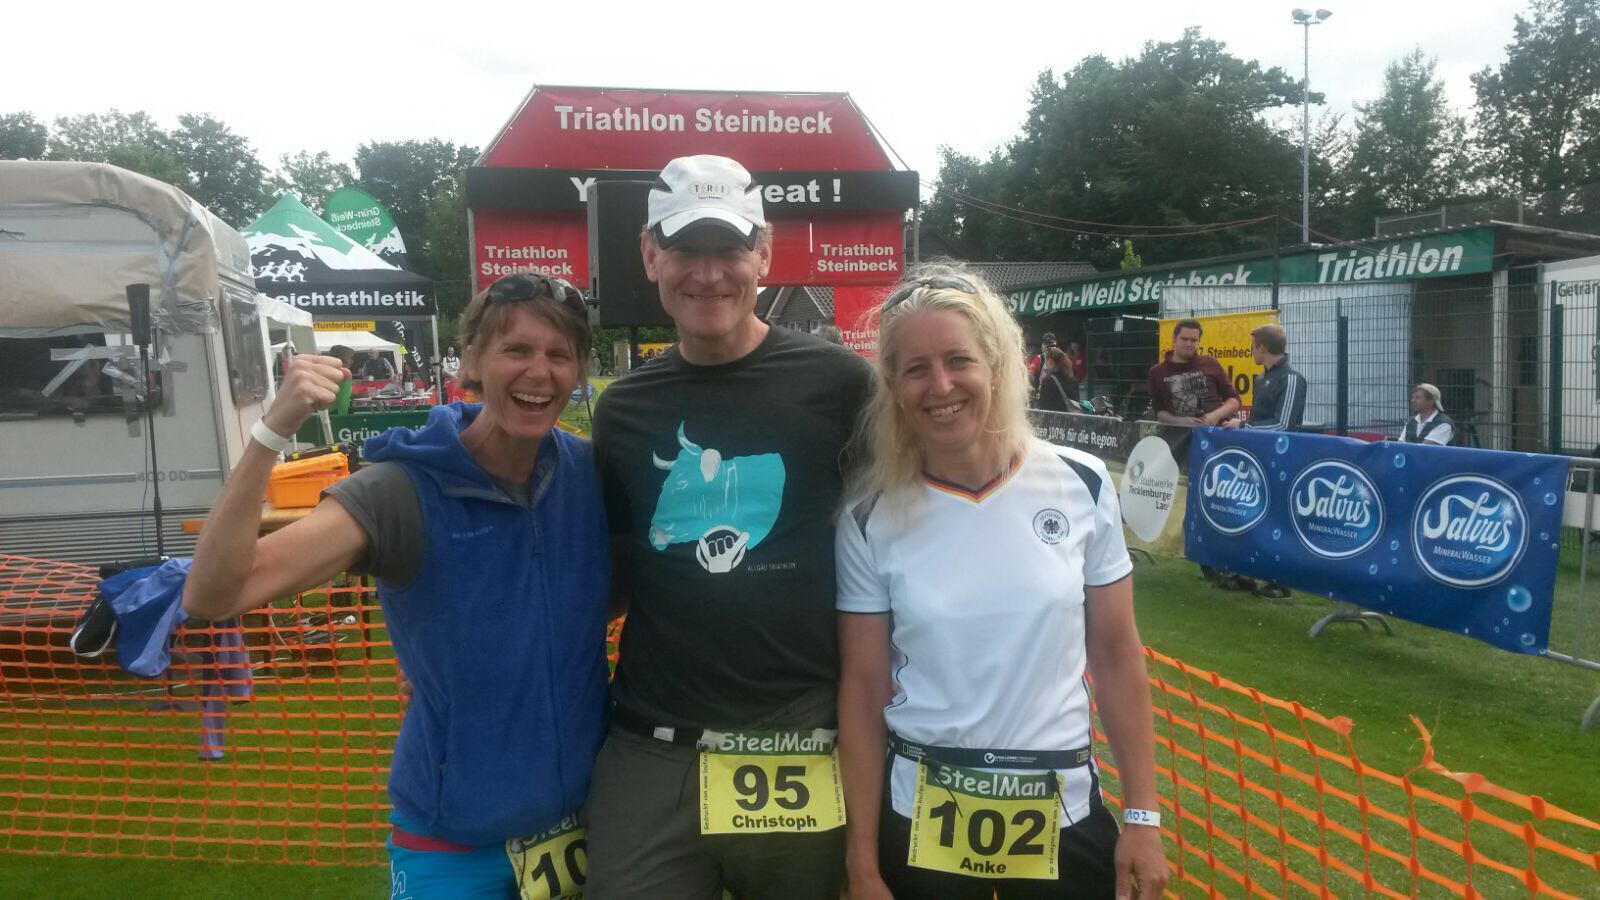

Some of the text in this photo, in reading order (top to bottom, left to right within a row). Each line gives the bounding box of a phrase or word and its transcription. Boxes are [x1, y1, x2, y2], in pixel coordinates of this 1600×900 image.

[554, 105, 833, 135] Triathlon Steinbeck
[758, 178, 821, 203] eat
[484, 245, 568, 259] Triathlon
[820, 243, 894, 256] Triathlon
[817, 259, 898, 272] Steinbeck
[1317, 242, 1464, 284] Triathlon
[273, 289, 426, 307] eichtathletik
[1033, 280, 1126, 311] Grün-Weiß
[312, 321, 368, 332] rtunterlagen
[1090, 432, 1119, 448] Region.
[1203, 460, 1261, 508] Salvus
[1296, 474, 1372, 529] Salvus
[1423, 491, 1513, 552] Salvus
[719, 731, 824, 752] SteelMan
[732, 764, 810, 811] 95
[935, 765, 1047, 798] SteelMan
[732, 815, 817, 830] Christoph
[1126, 809, 1149, 821] 102
[929, 799, 1047, 857] 102
[531, 838, 588, 899] 10
[959, 857, 1007, 875] Anke
